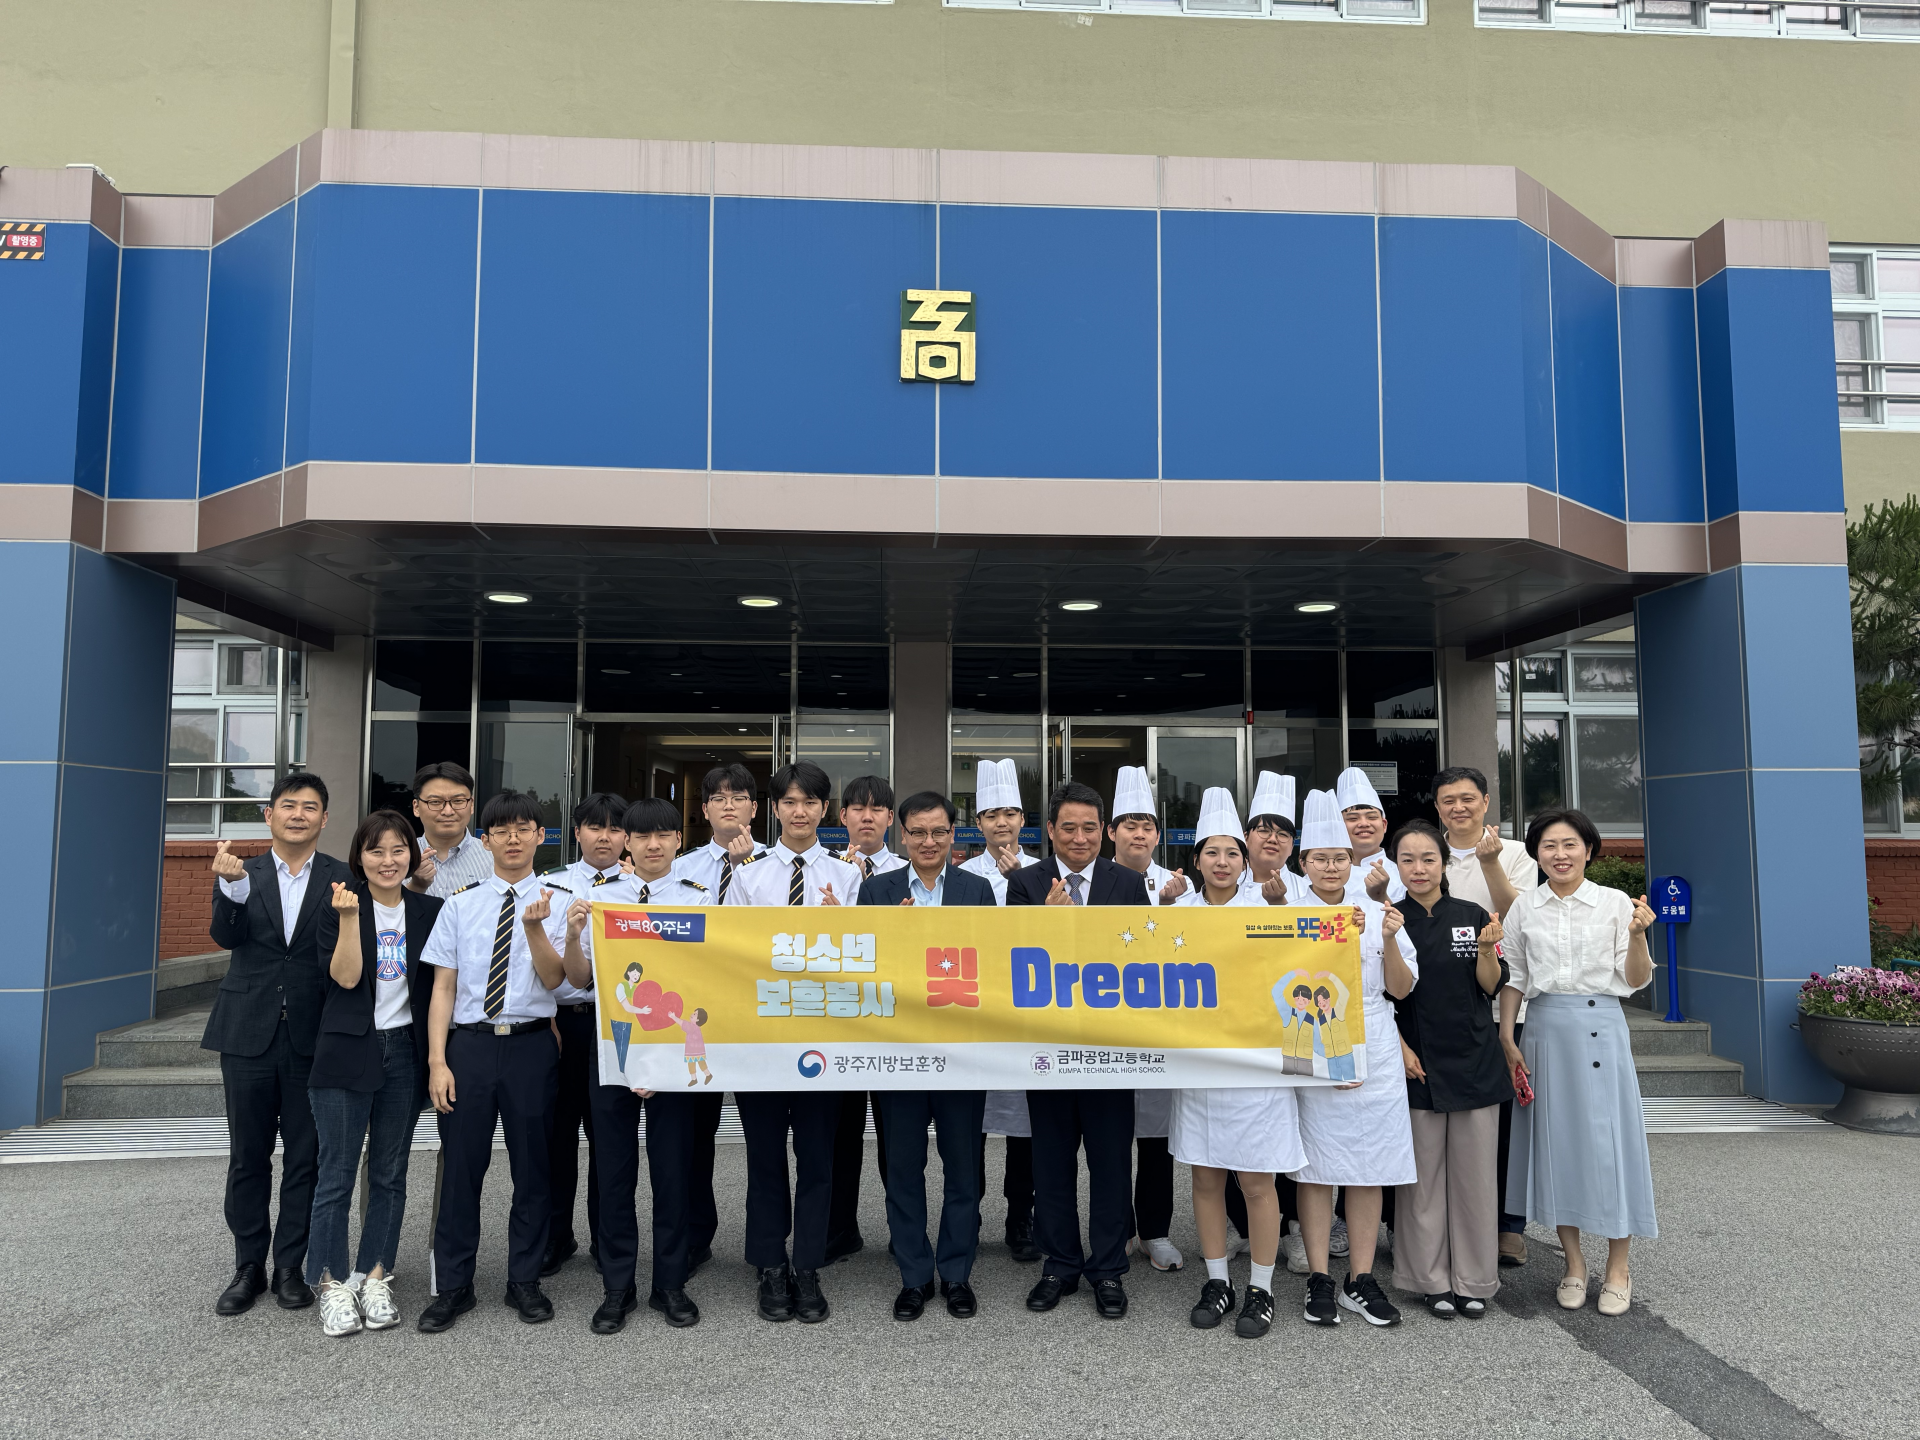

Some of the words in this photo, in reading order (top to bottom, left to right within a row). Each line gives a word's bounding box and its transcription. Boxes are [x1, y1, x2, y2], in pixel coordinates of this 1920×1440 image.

[12, 235, 38, 246] 촬영중
[1662, 905, 1686, 915] 도움벨
[615, 918, 691, 935] 광복80주년
[771, 932, 876, 973] 청소년
[926, 947, 980, 1008] 빛
[1010, 946, 1218, 1009] Dream
[756, 979, 896, 1018] 보훈봉사
[833, 1055, 947, 1074] 광주지방보훈청
[1056, 1050, 1166, 1065] 금파공업고등학교
[1138, 1066, 1166, 1074] SCHOOL
